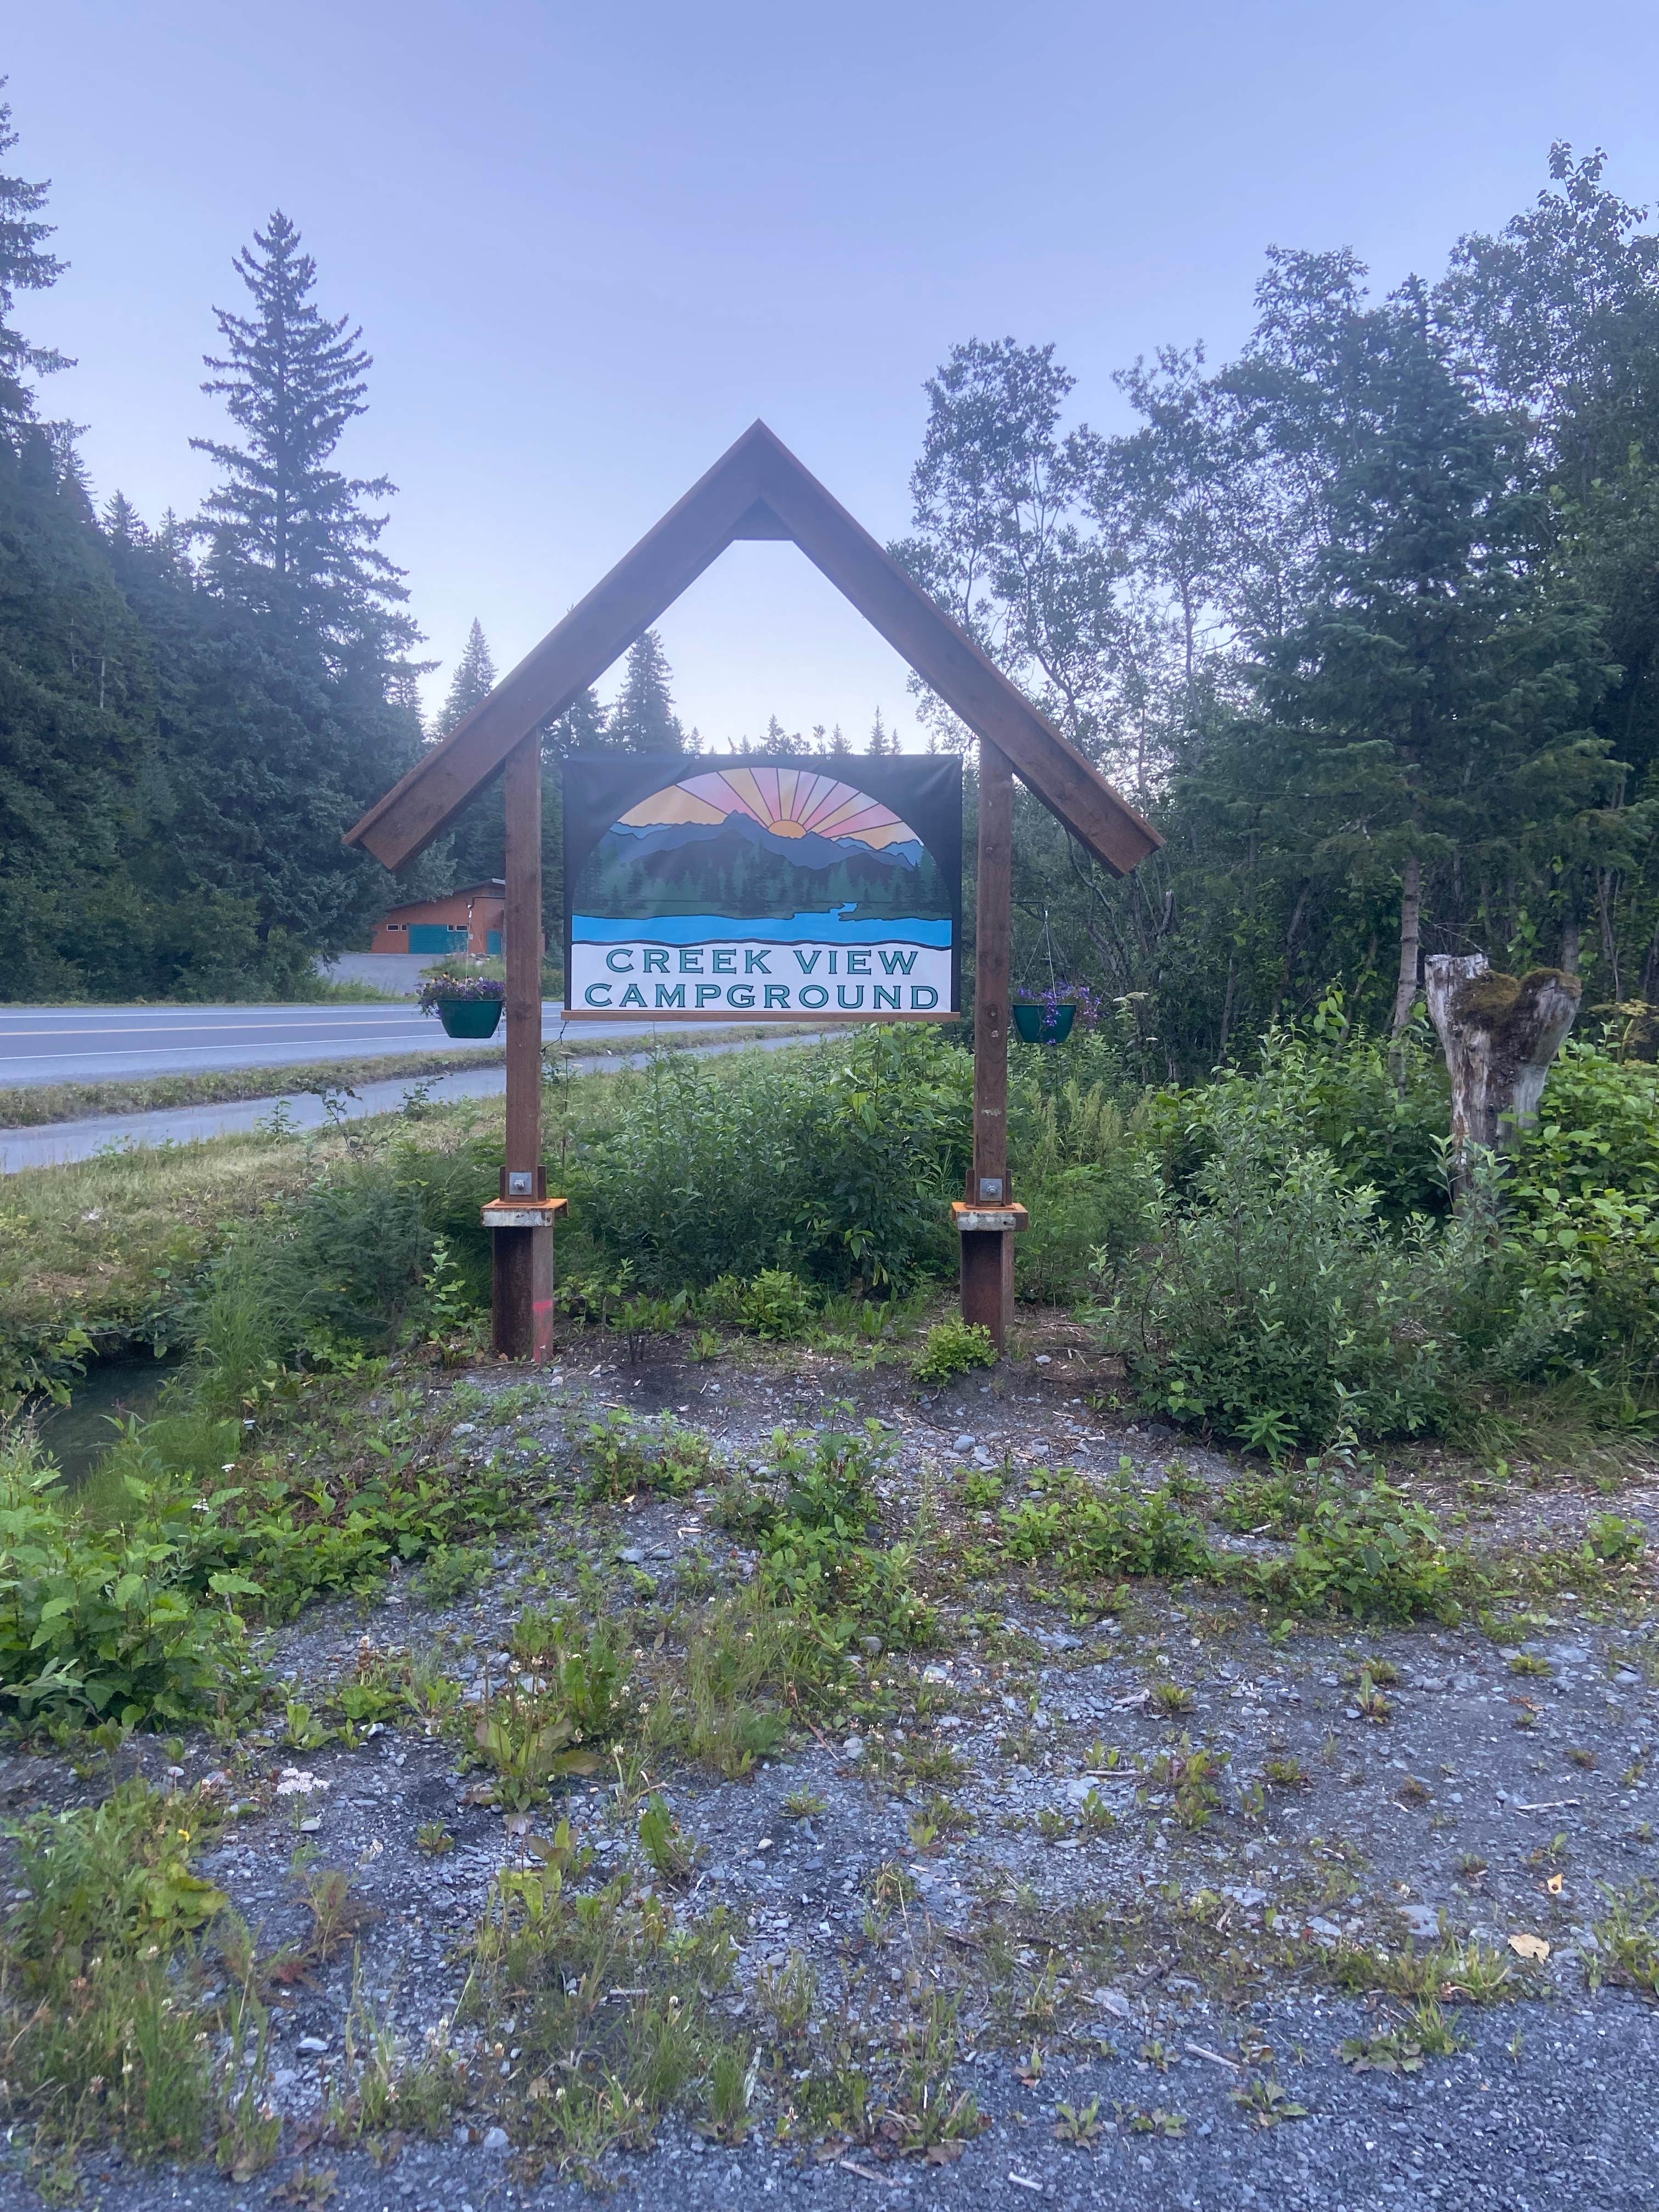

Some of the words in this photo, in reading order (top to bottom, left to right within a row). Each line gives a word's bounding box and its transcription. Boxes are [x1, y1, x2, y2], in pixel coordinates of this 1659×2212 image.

[606, 949, 771, 974] CREEK
[793, 950, 918, 975] VIEW
[584, 983, 939, 1009] CAMPGROUND
